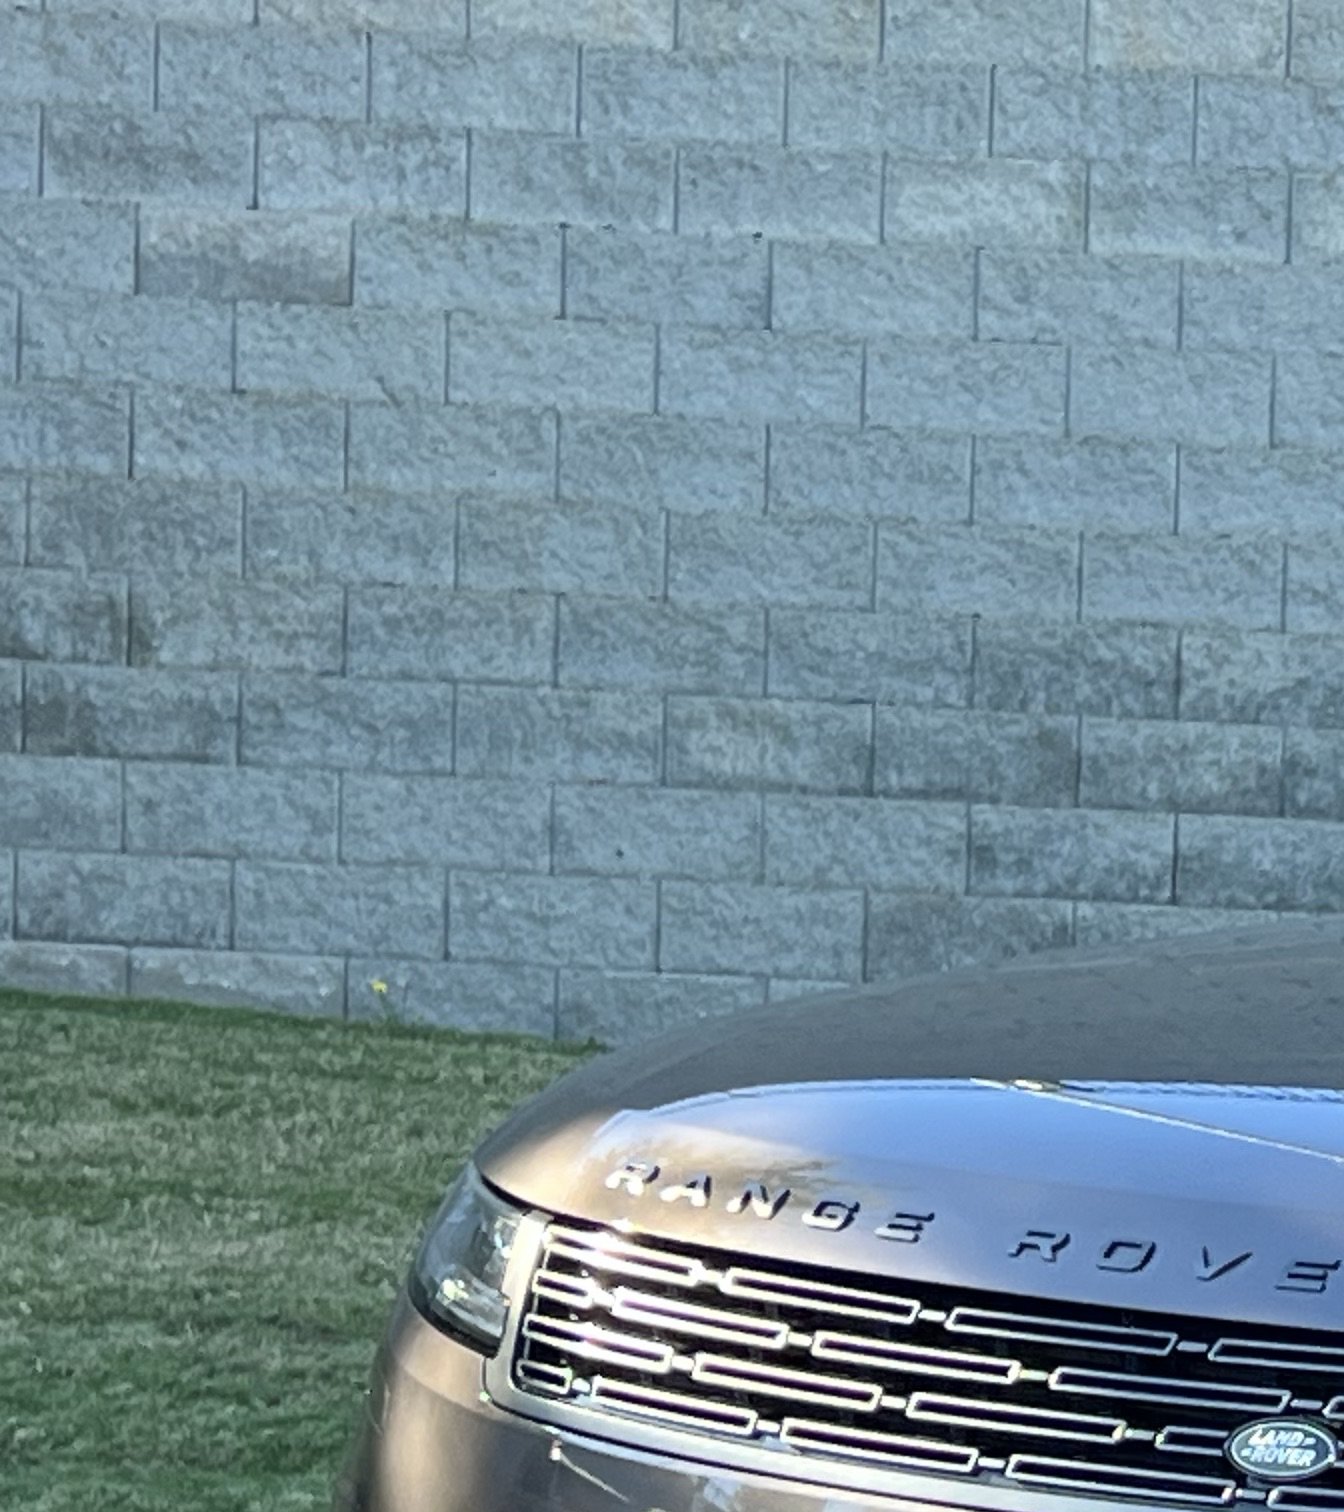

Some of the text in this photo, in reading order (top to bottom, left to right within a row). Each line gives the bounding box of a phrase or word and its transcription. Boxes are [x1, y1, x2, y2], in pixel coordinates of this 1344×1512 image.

[605, 1161, 935, 1243] RANGE
[1248, 1429, 1305, 1447] LAND
[1251, 1446, 1317, 1467] ROVER
